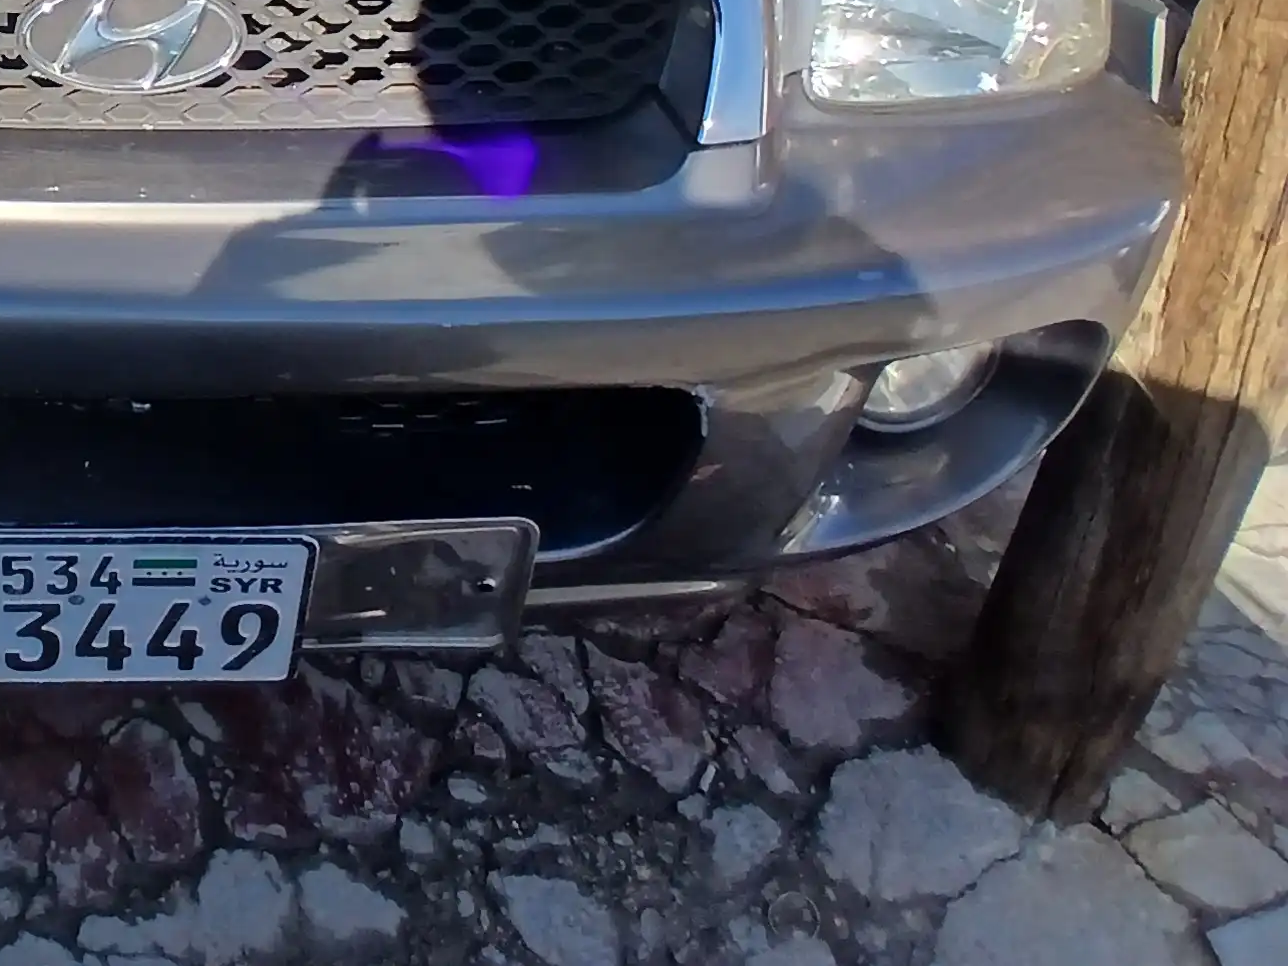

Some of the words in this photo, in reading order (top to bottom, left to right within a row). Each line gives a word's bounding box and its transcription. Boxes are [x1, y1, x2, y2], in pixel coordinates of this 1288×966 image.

[1, 555, 122, 595] 534
[213, 553, 288, 573] سورية
[209, 577, 283, 594] SYR
[3, 602, 280, 672] 3449
